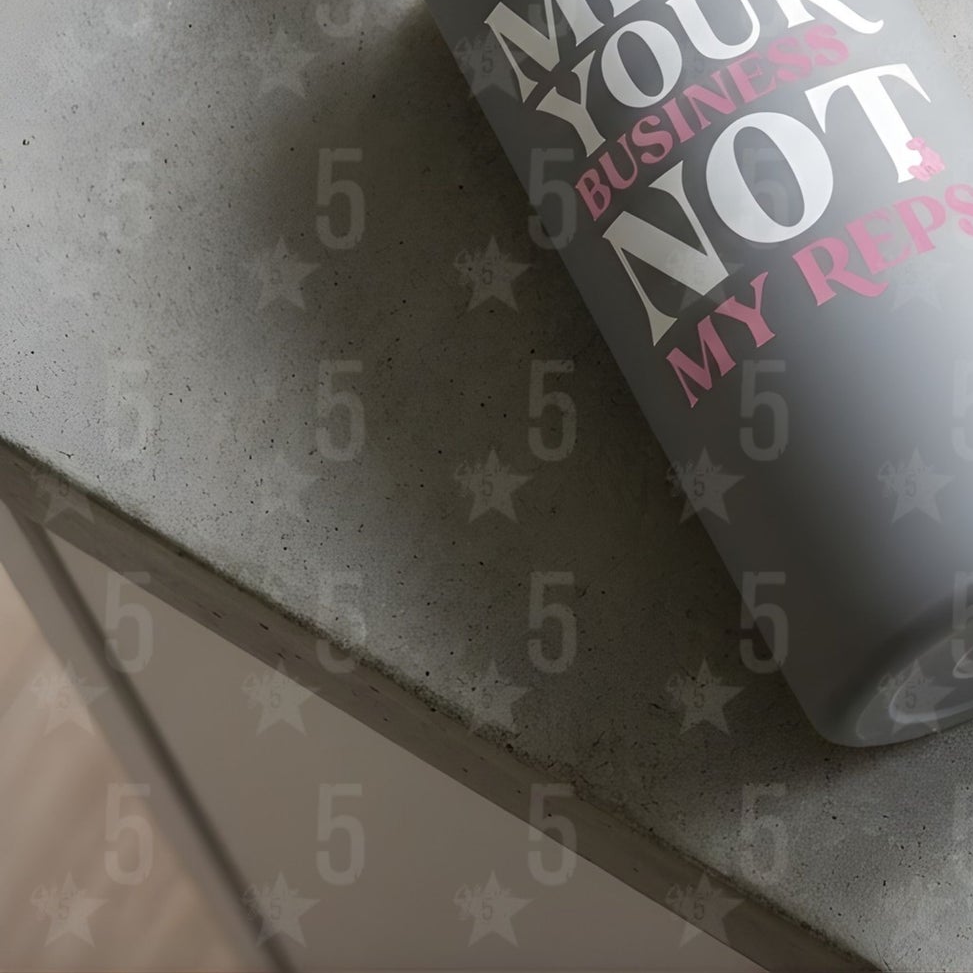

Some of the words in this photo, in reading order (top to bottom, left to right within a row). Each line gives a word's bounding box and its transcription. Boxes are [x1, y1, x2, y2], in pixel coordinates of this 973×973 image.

[575, 23, 849, 222] BUSINESS
[602, 63, 932, 346] NOT
[665, 272, 776, 409] MY
